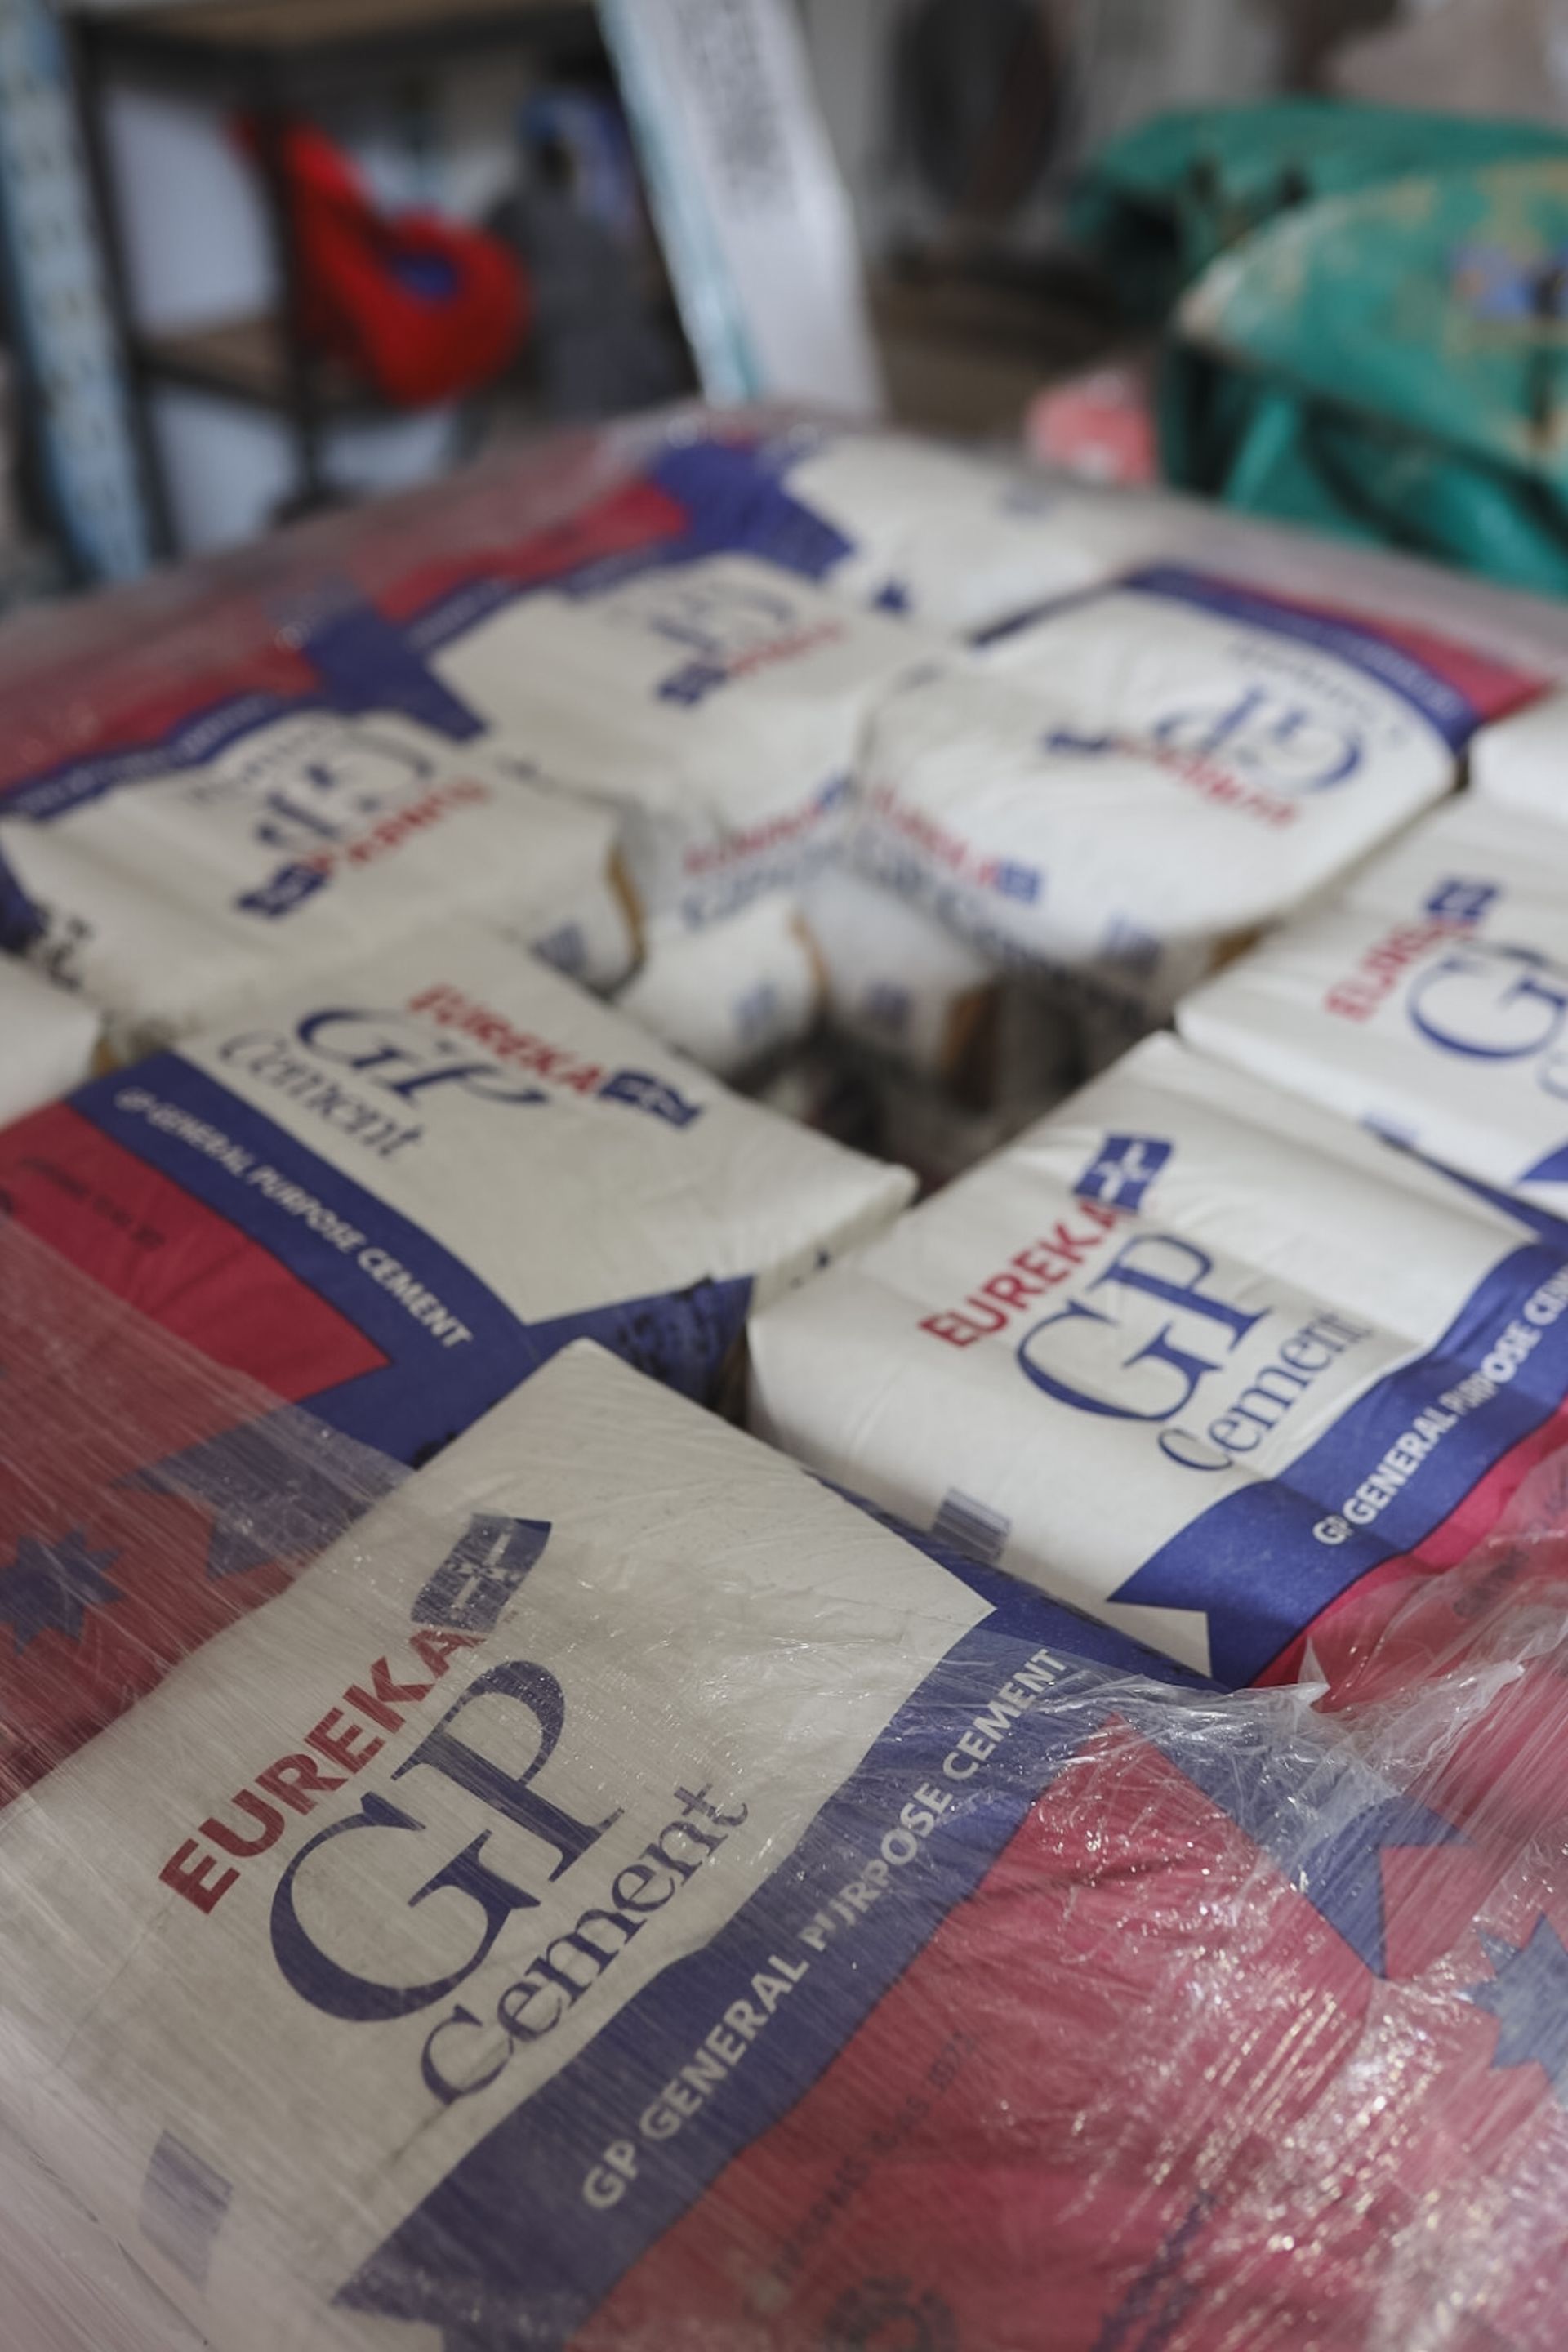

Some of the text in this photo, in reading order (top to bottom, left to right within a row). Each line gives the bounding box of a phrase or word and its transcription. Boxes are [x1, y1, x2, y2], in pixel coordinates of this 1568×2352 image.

[246, 1165, 367, 1254] PURPOSE
[358, 1247, 473, 1348] CEMENT
[916, 1196, 1122, 1349] EUREKA
[1015, 1232, 1274, 1422] GP
[1158, 1309, 1374, 1472] Cement
[1343, 1406, 1459, 1525] GENERAL
[158, 1628, 488, 1914] EUREKA
[270, 1660, 625, 2022] GP
[421, 1783, 748, 2105] Cement
[582, 1648, 1067, 2209] GP GENERAL PURPOSE CEMENT
